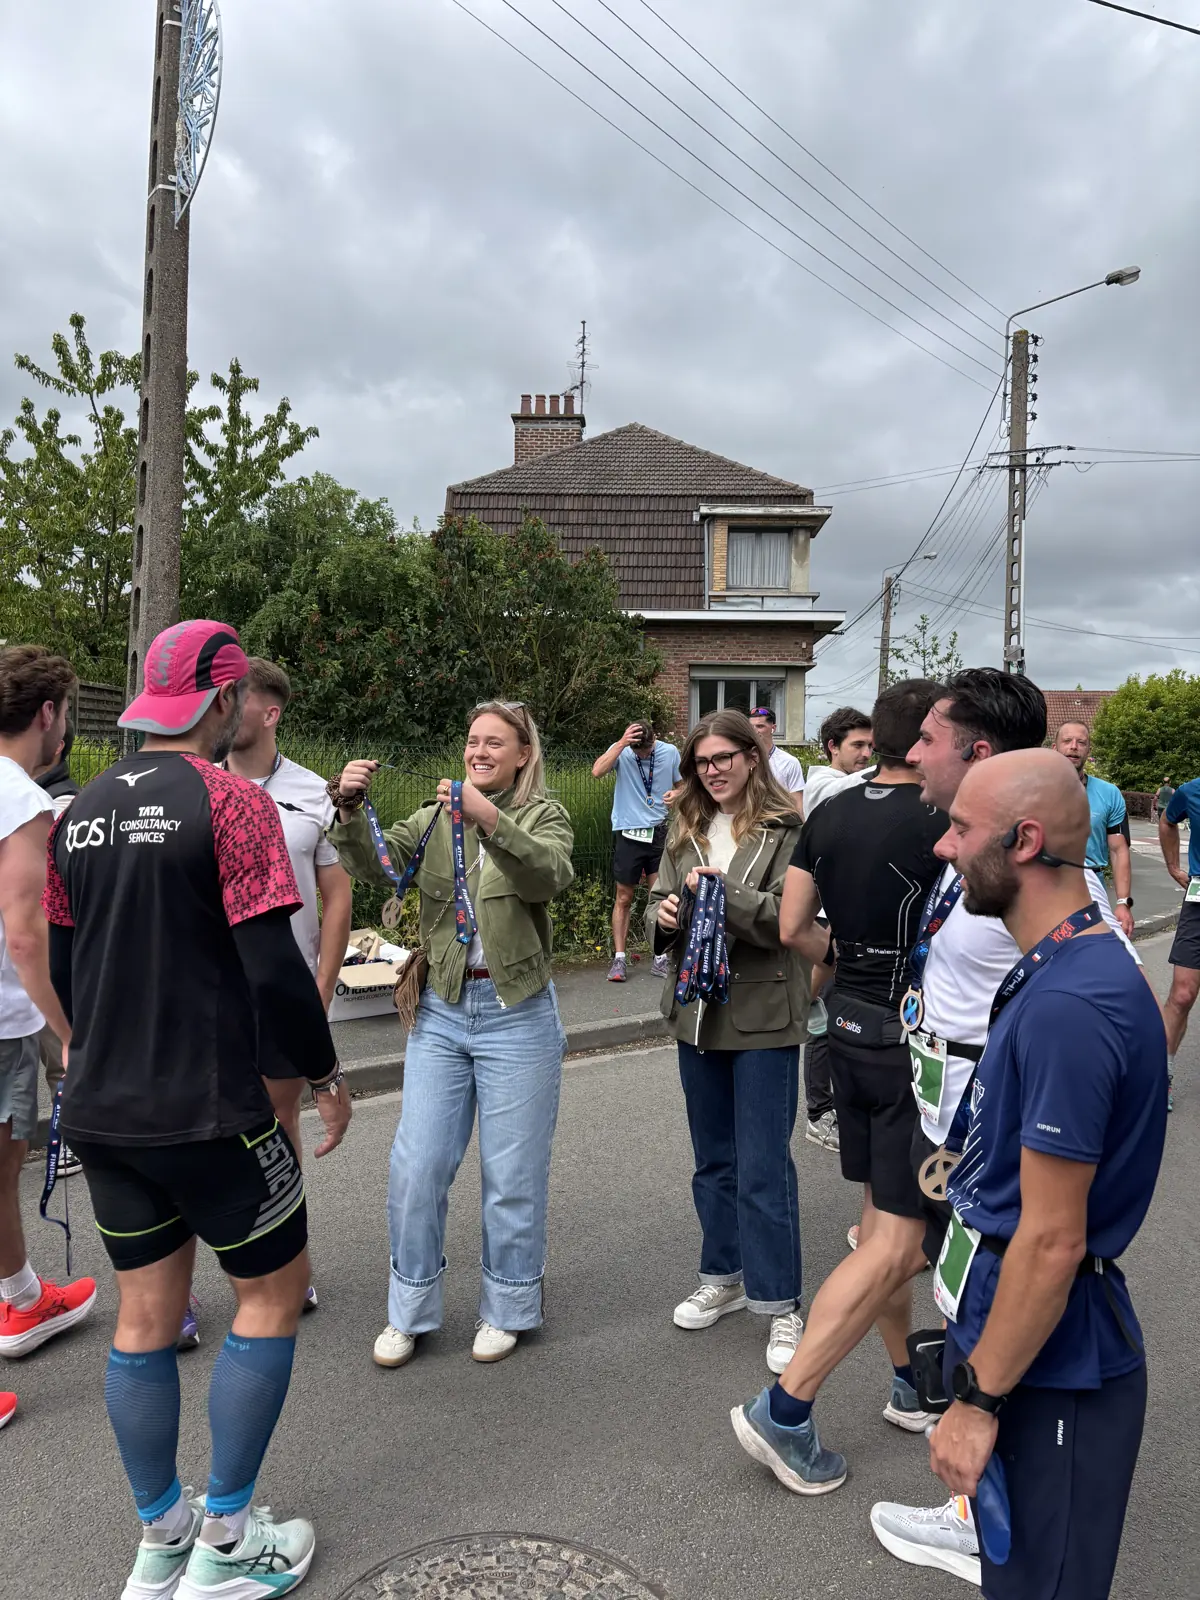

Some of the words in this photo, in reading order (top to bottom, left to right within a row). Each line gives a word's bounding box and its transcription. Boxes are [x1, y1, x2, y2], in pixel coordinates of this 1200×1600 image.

[138, 806, 164, 817] TATA
[119, 819, 182, 832] CONSULTANCY
[127, 832, 166, 844] SERVICES
[462, 888, 475, 919] FINISHER
[836, 1016, 862, 1034] Oxsitis
[1036, 1122, 1061, 1134] KIPRUN
[47, 1153, 57, 1190] FINISHER
